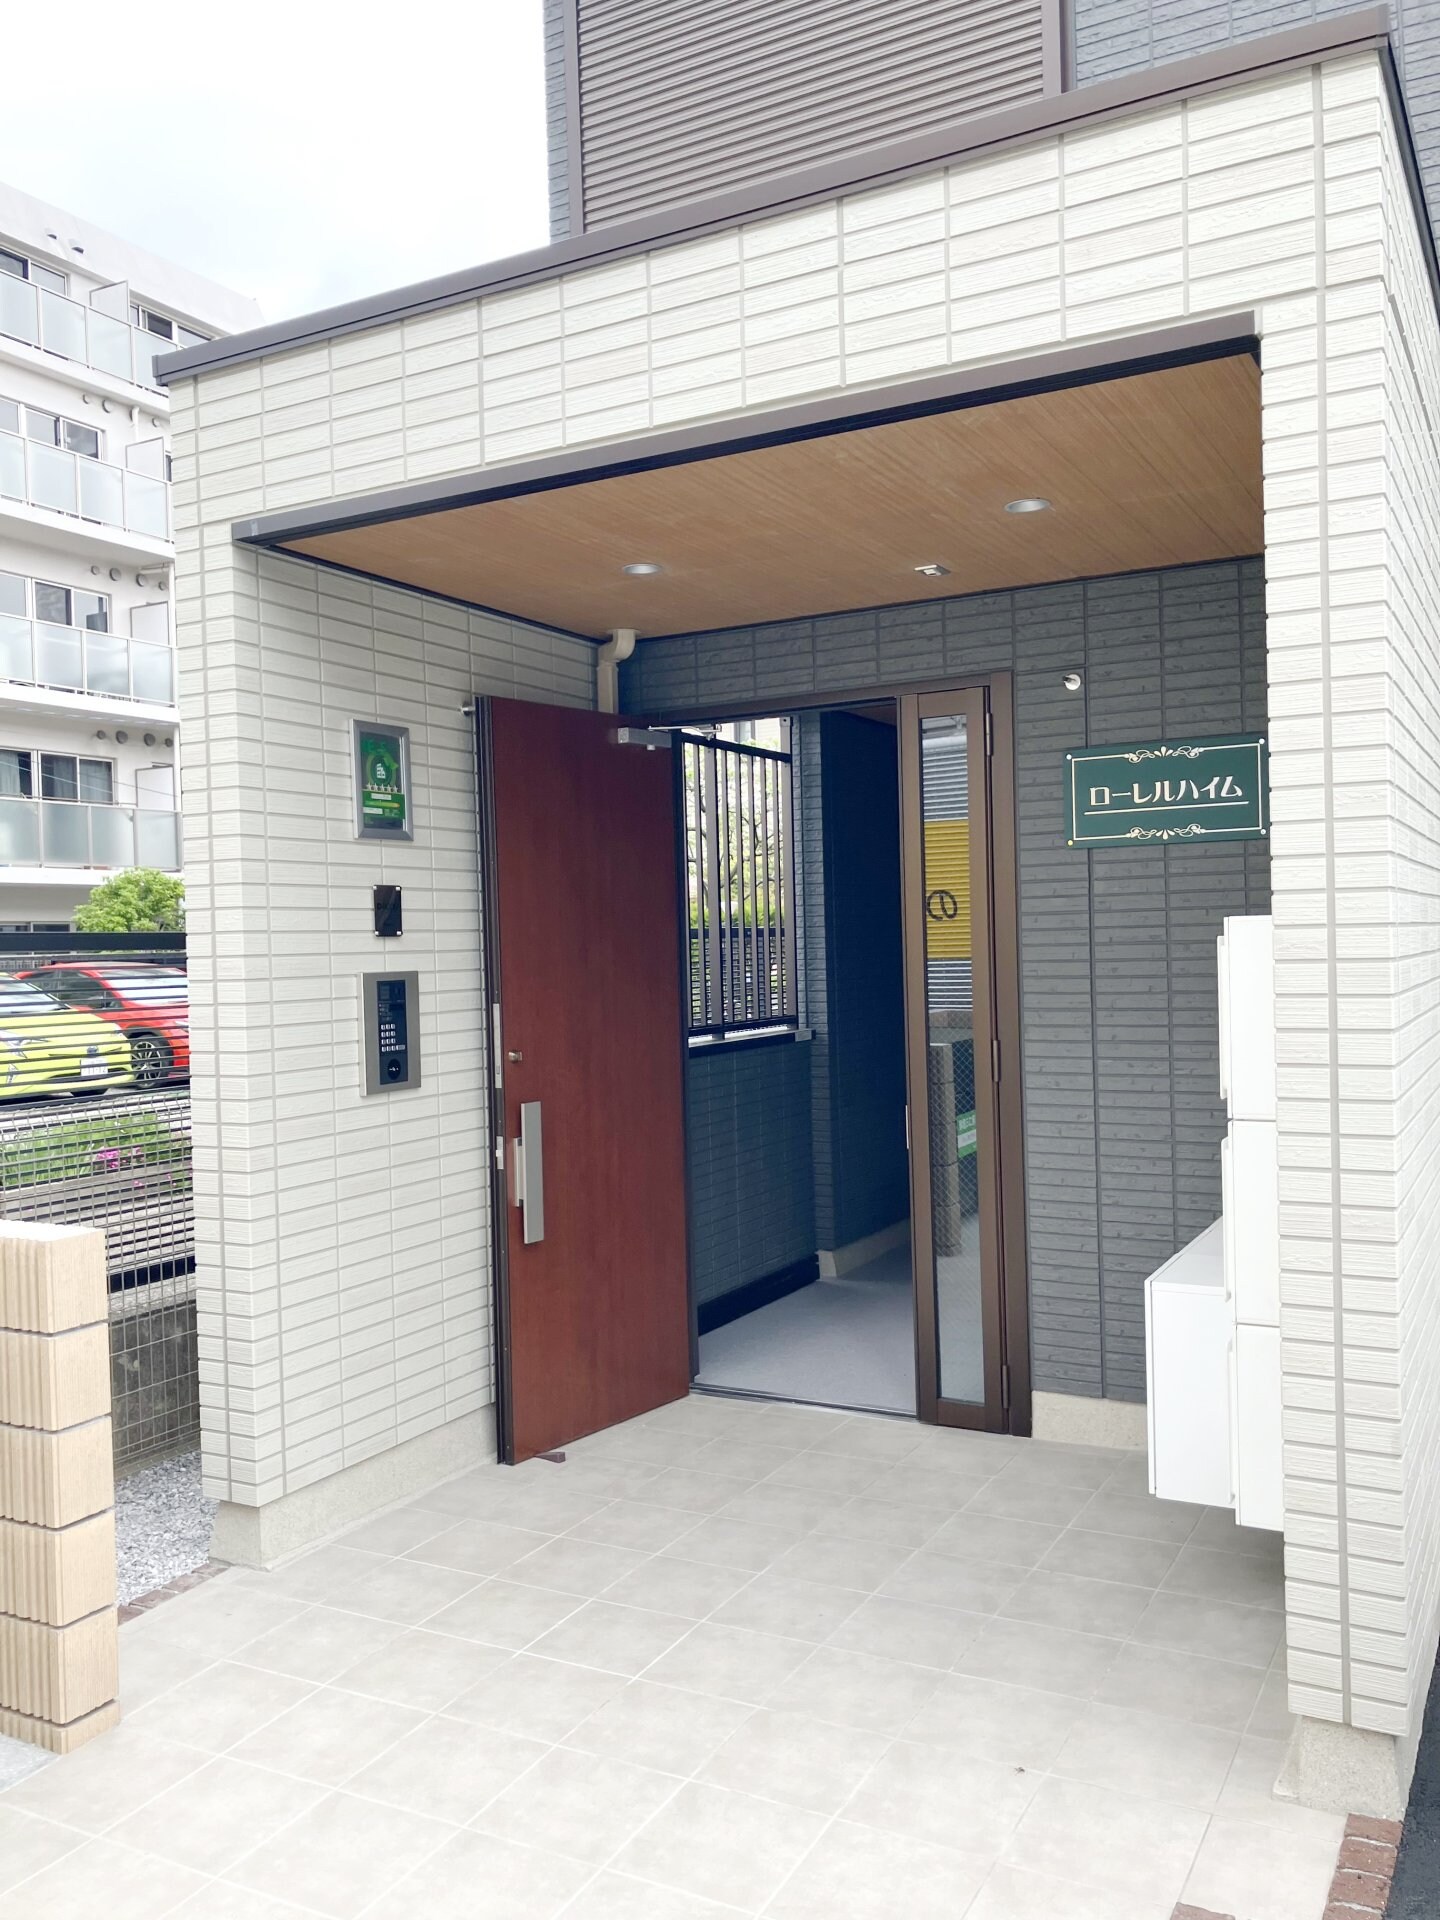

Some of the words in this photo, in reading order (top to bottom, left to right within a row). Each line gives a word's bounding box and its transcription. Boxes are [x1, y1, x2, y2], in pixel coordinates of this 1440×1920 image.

[1089, 775, 1243, 806] ローレルハイム
